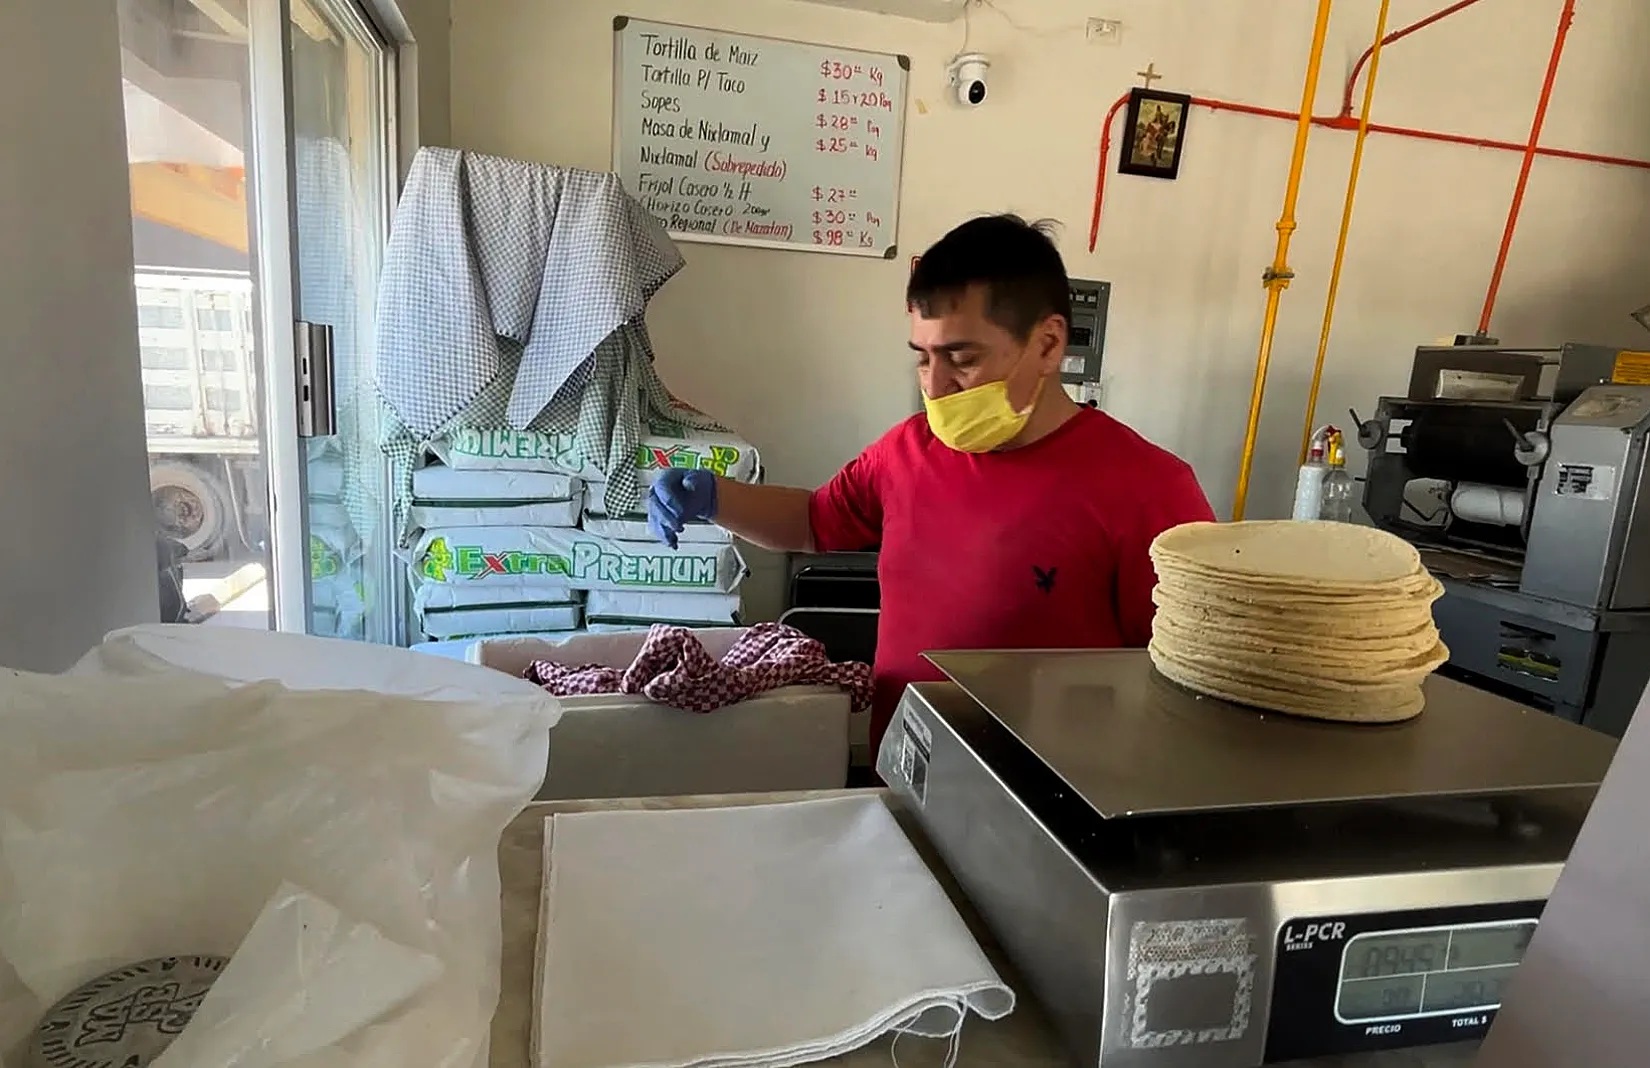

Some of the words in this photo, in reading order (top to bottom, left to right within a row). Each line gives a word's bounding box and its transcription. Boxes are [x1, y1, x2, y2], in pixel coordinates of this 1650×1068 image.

[640, 34, 697, 60] Tortilla
[705, 42, 720, 62] de
[641, 64, 690, 86] Tortilla
[717, 71, 745, 94] Taco
[869, 67, 883, 87] Kg
[640, 89, 681, 114] Sopes
[641, 117, 675, 138] Masa
[679, 118, 693, 139] de
[760, 134, 771, 153] y
[638, 173, 674, 197] Frijol
[678, 175, 718, 198] Casero
[693, 199, 733, 216] Casero
[670, 214, 717, 233] Regional
[455, 545, 572, 580] Extra
[571, 541, 717, 586] PREMIUM
[1284, 921, 1346, 944] L-PCR
[1365, 1023, 1401, 1036] PRECIO
[1452, 1017, 1479, 1028] TOTAL
